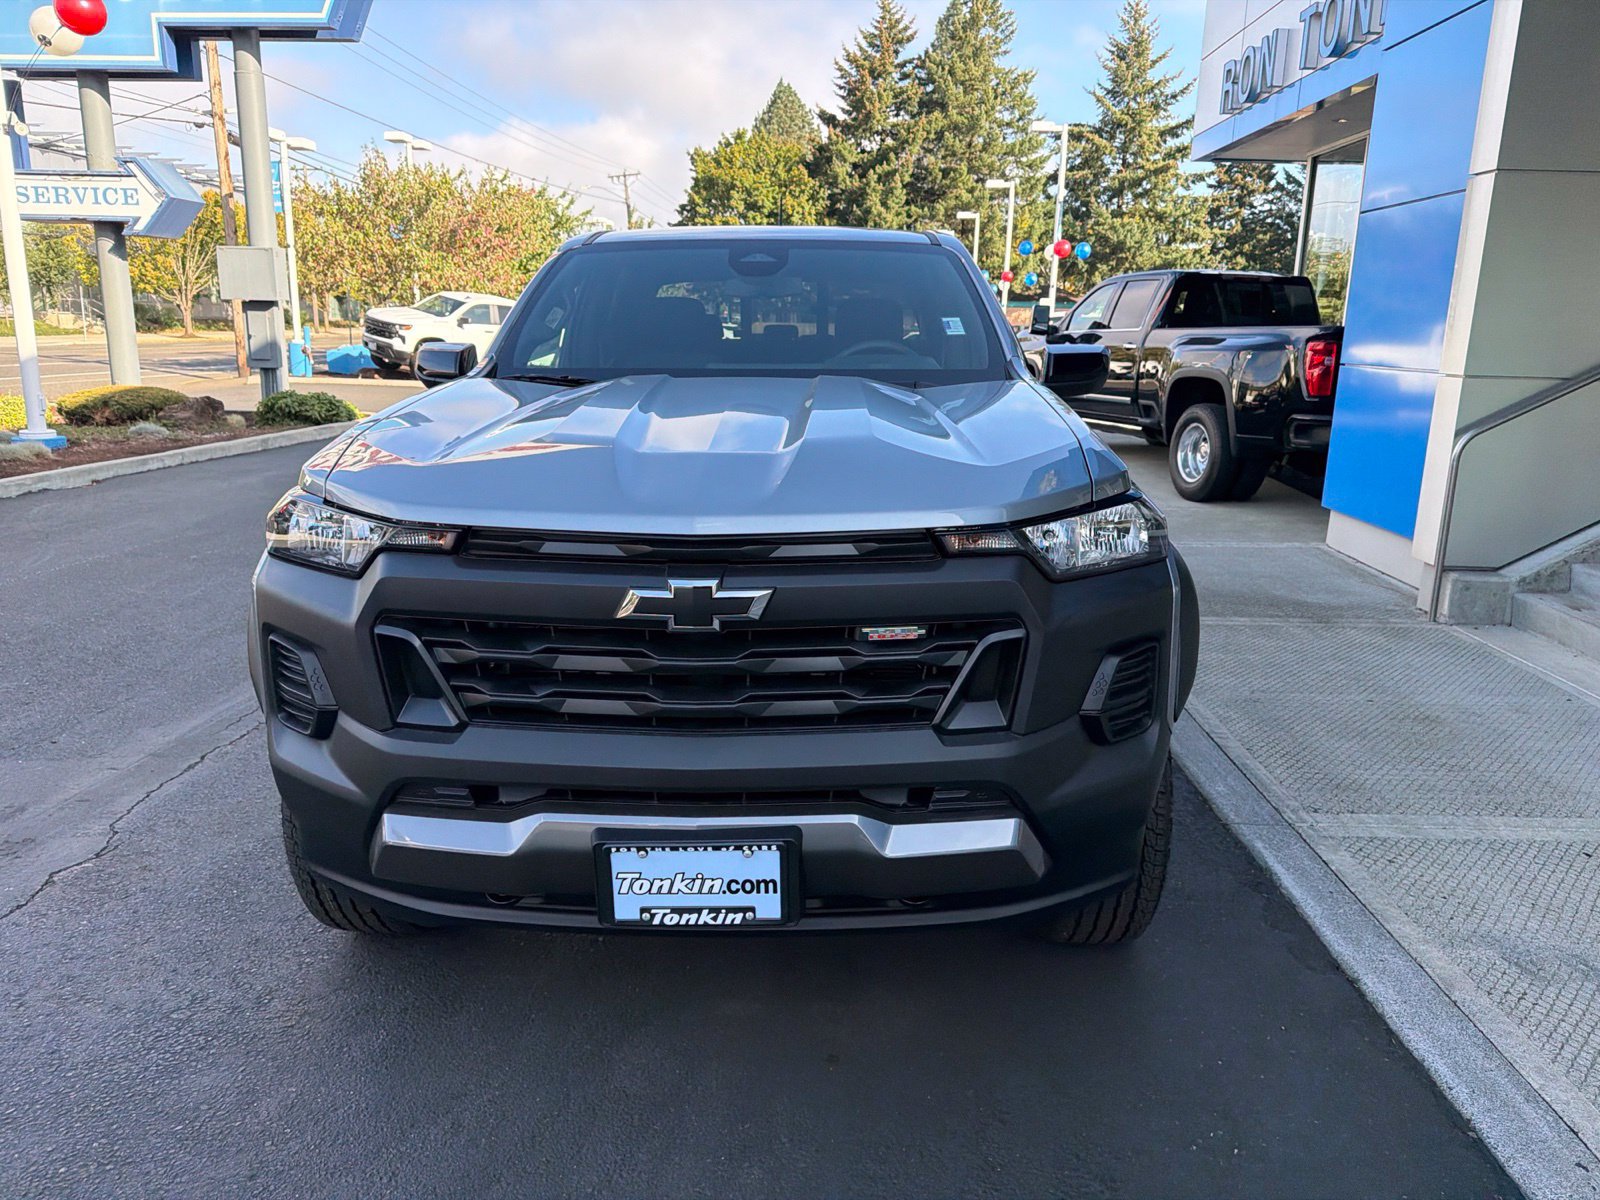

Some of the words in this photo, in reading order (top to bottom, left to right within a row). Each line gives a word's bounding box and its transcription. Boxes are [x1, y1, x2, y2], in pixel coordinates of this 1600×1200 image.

[1220, 28, 1289, 115] RON
[16, 185, 140, 206] SERVICE
[616, 872, 778, 895] Tonkin.com
[651, 908, 744, 925] Tonkin
